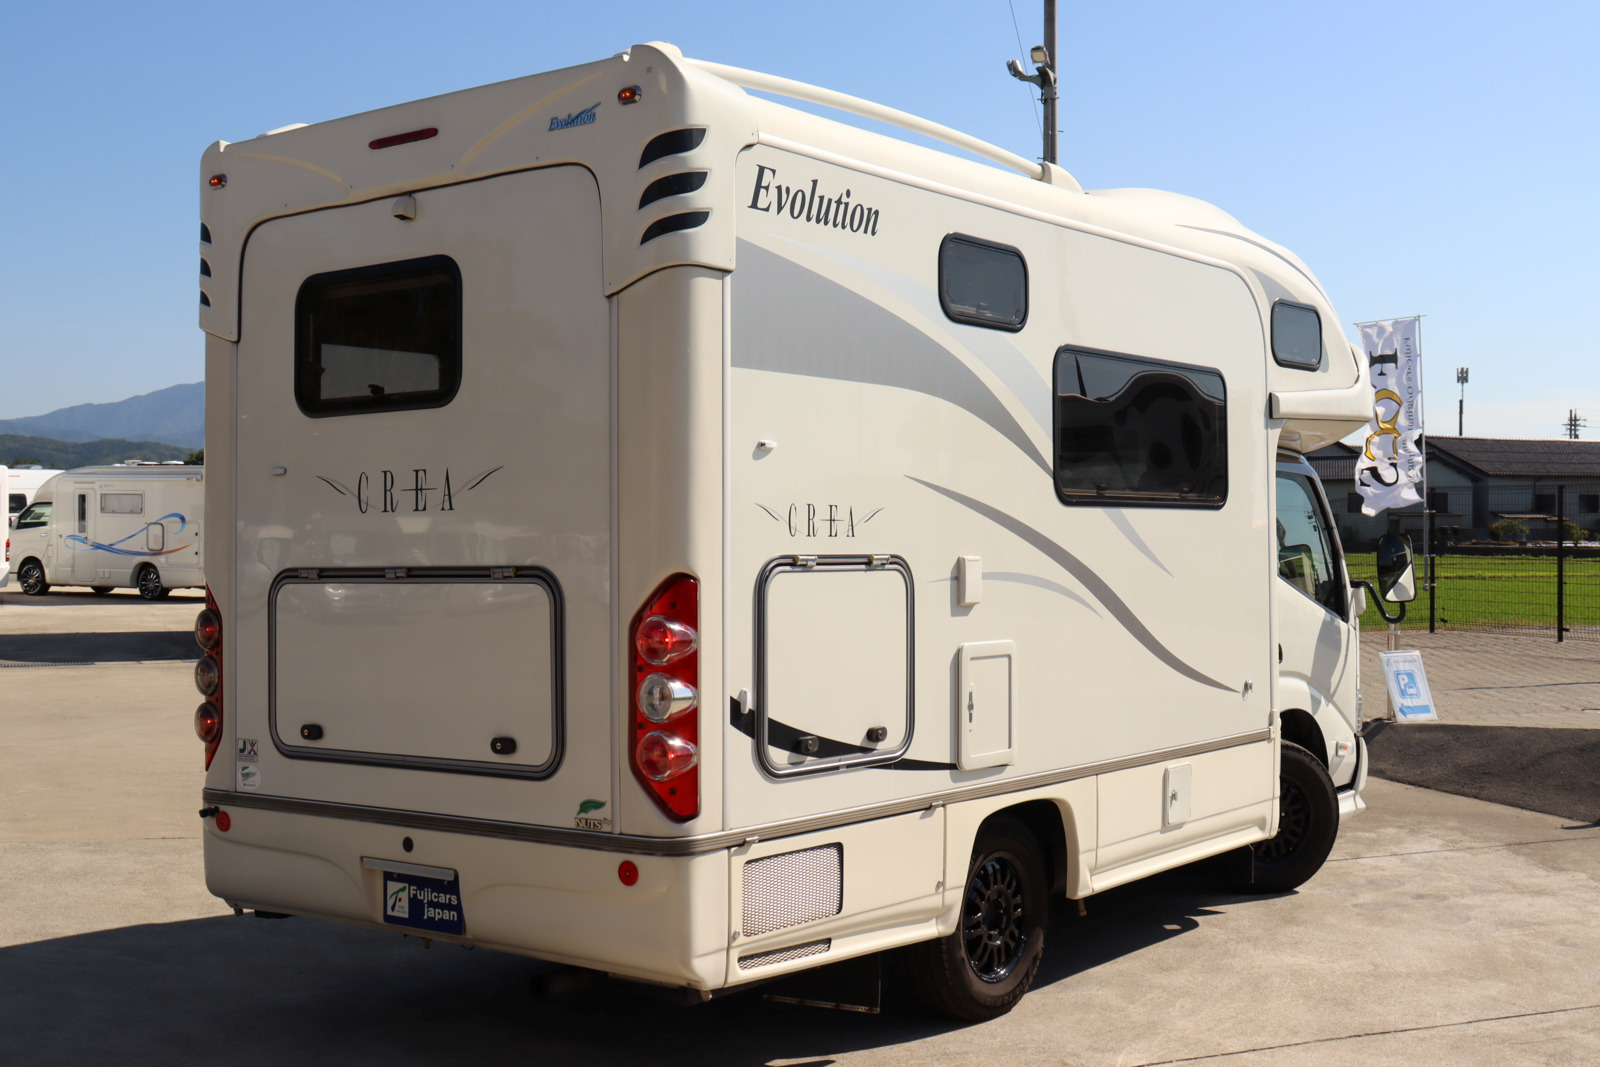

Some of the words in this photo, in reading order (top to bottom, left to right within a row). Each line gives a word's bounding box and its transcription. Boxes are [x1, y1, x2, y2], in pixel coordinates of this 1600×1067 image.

[548, 109, 597, 132] Evolution
[747, 164, 880, 237] Evolution
[357, 467, 454, 514] CREA
[788, 502, 856, 538] CREA
[1398, 674, 1409, 690] P
[574, 817, 602, 830] NUTS
[409, 885, 458, 905] Fujicars
